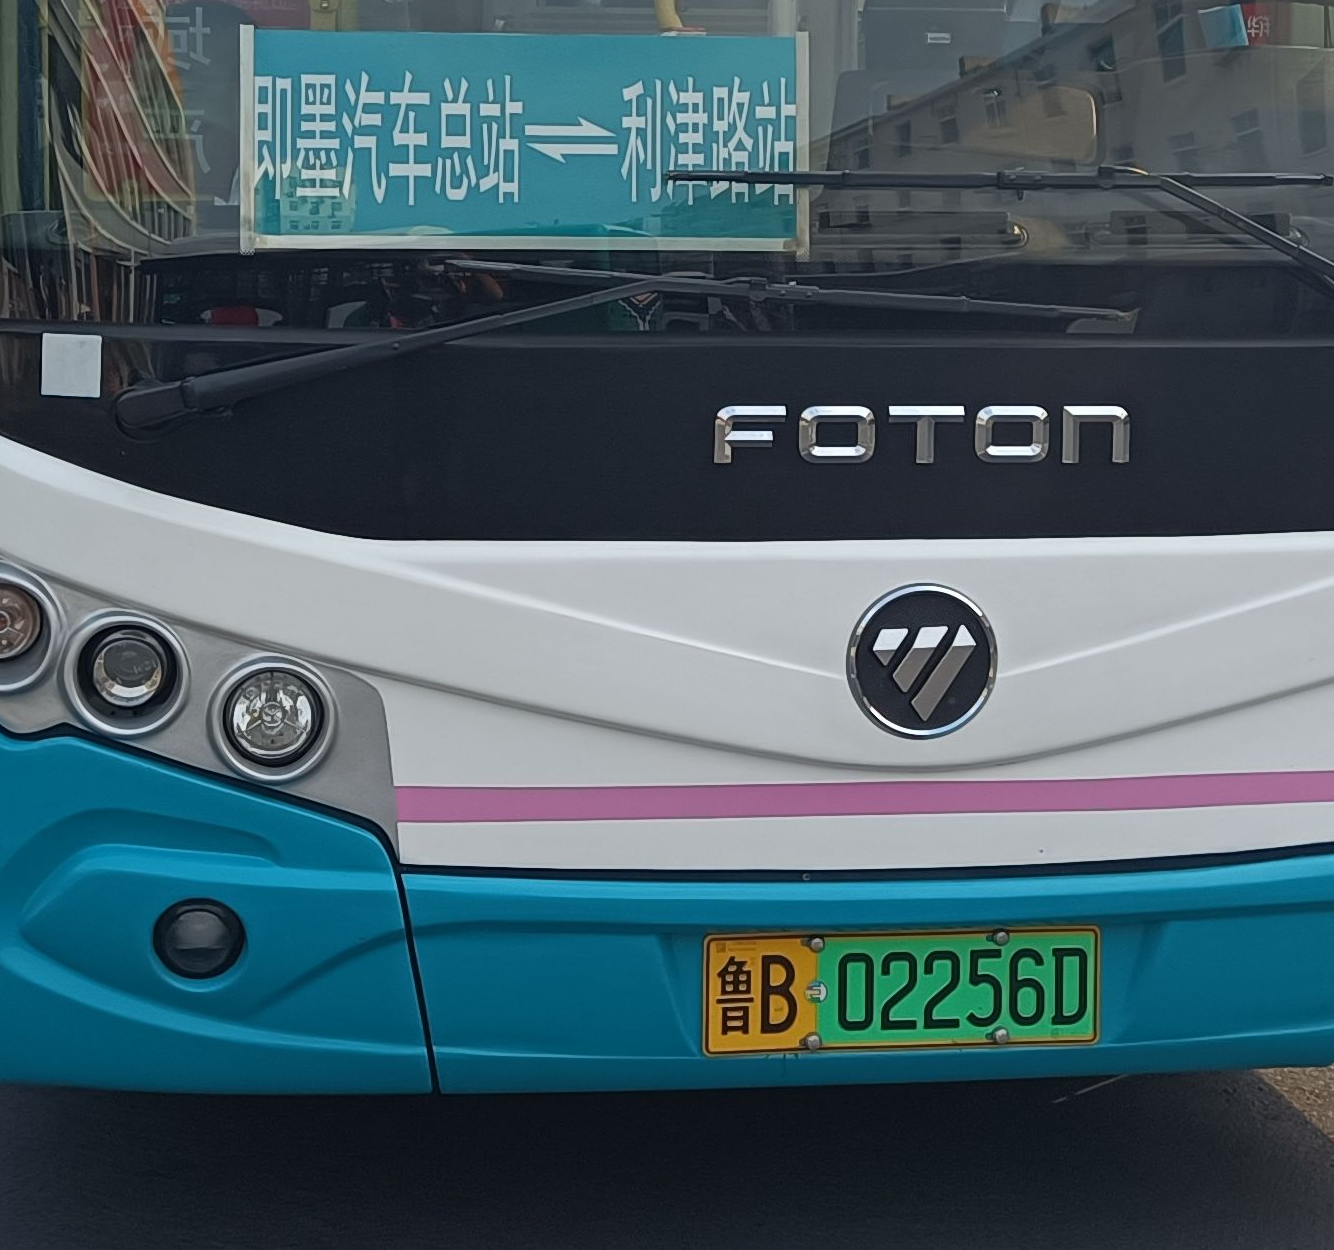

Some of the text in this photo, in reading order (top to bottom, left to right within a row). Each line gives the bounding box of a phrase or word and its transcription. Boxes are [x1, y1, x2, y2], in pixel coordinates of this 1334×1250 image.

[253, 70, 796, 206] 即墨汽车总站 利津路站
[713, 405, 1131, 464] FOTON
[715, 947, 1089, 1036] 鲁B 02256D
